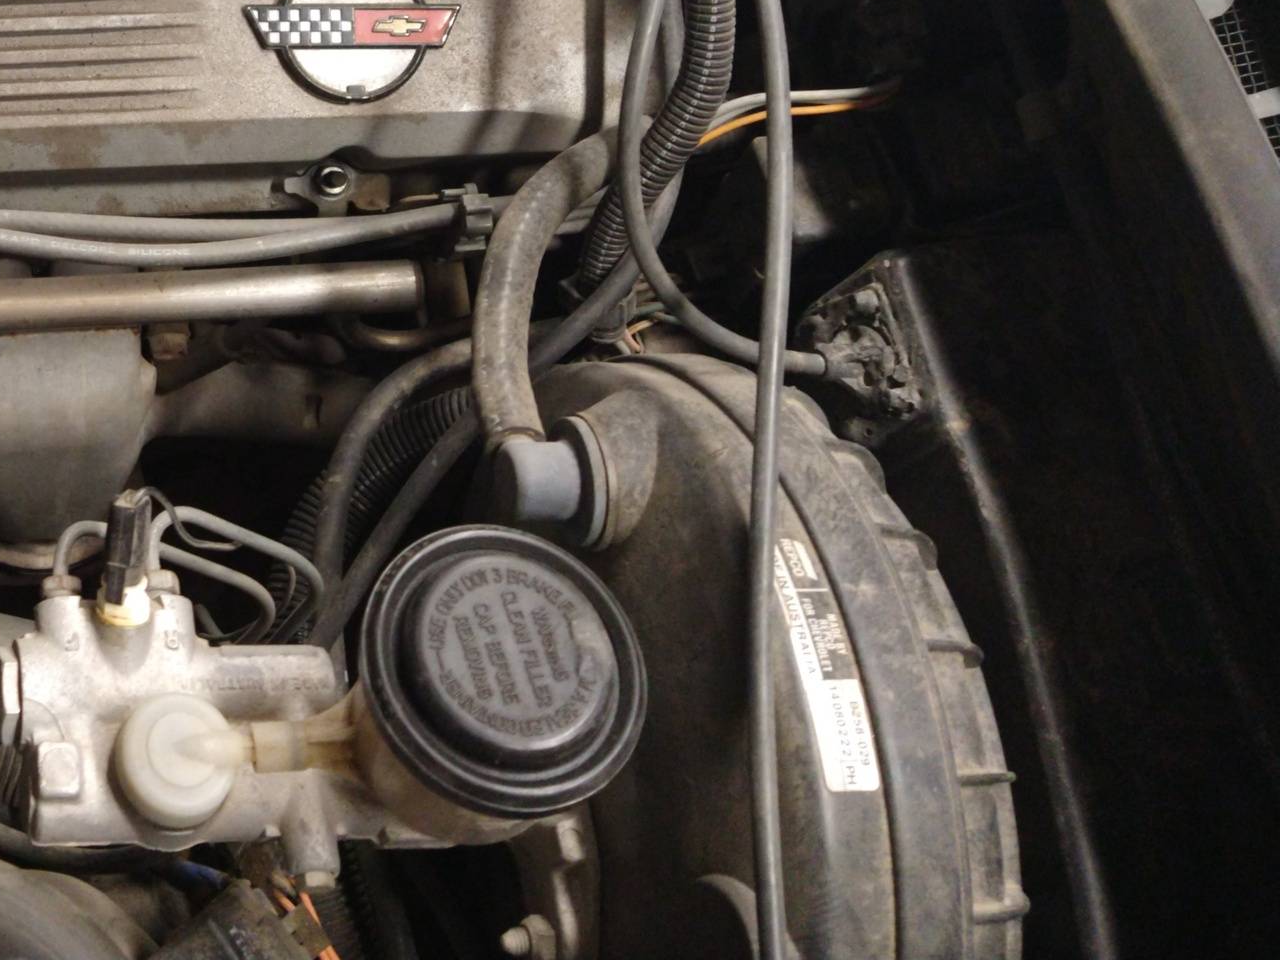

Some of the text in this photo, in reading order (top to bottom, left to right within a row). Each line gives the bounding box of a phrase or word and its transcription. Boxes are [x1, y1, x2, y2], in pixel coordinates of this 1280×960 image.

[491, 567, 502, 583] 3
[506, 568, 563, 605] BRAKE
[780, 538, 804, 577] REPCO
[473, 602, 520, 706] CAP BEFORE
[501, 591, 553, 708] CLEAN FILLER
[782, 590, 816, 674] AUSTRALIA
[801, 597, 833, 672] FOR CHEVROLET
